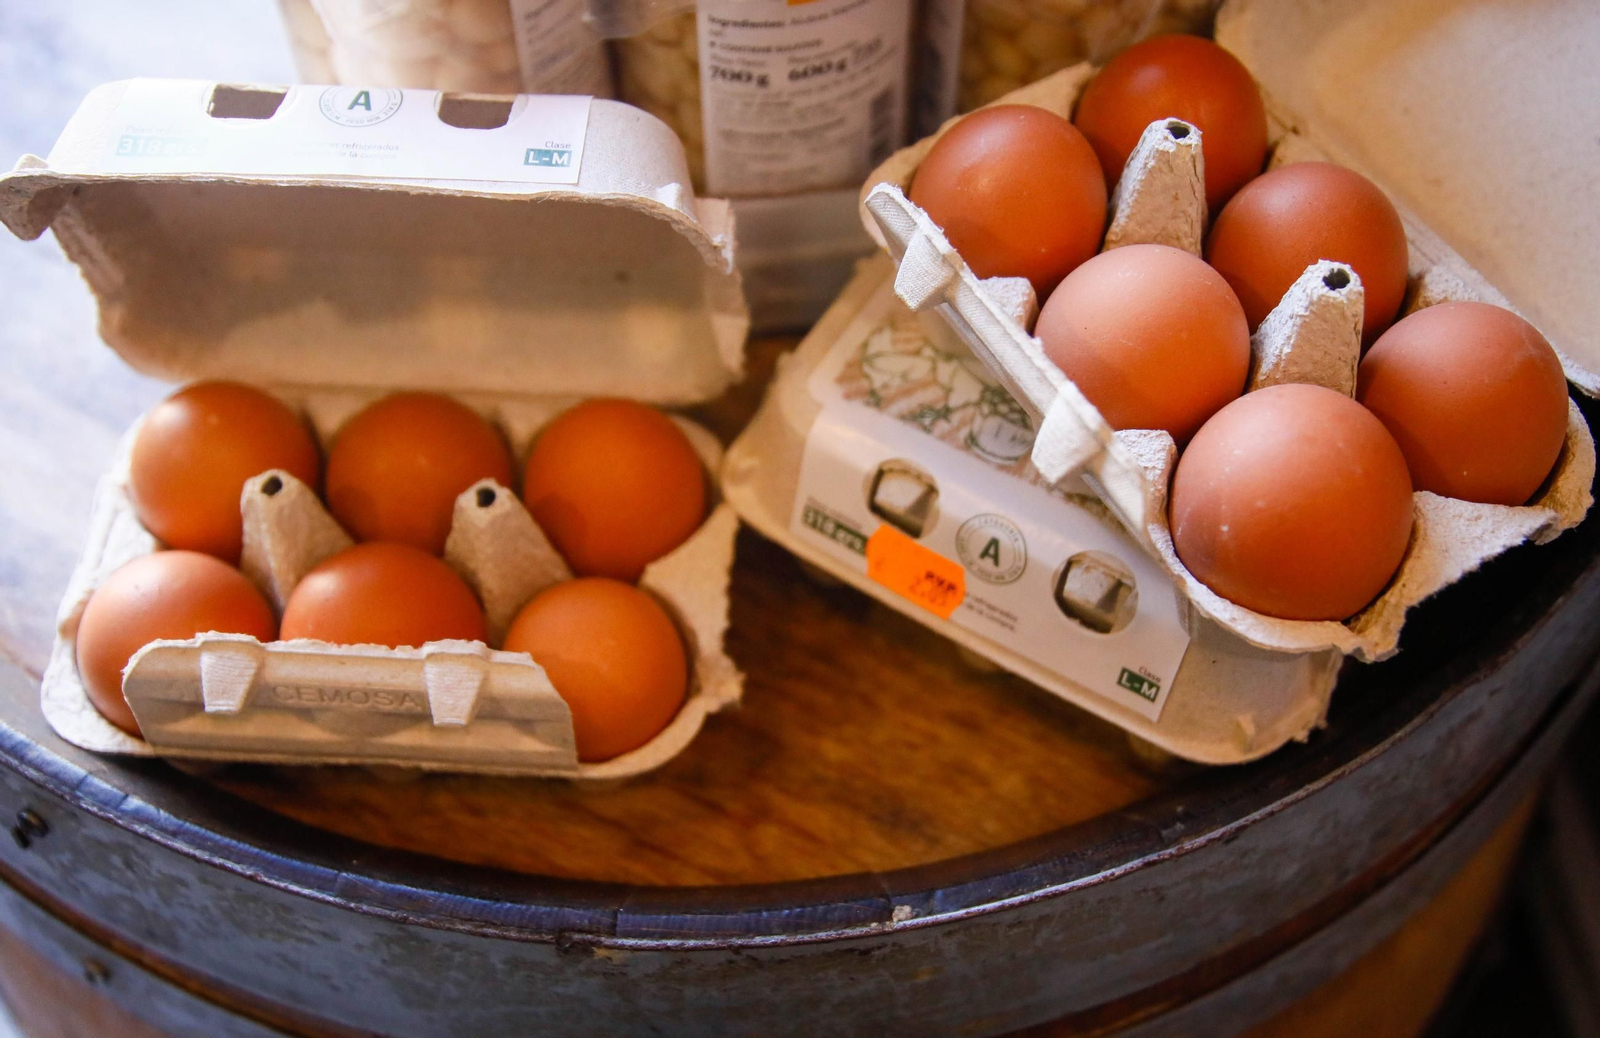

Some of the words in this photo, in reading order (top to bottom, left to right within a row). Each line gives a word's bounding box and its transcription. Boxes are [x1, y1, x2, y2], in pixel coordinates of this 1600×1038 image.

[346, 89, 373, 112] A
[341, 142, 399, 152] refrigerados
[544, 140, 571, 150] Clase
[979, 536, 1001, 567] A
[1138, 666, 1162, 683] Clase
[272, 685, 423, 712] CEMOSA
